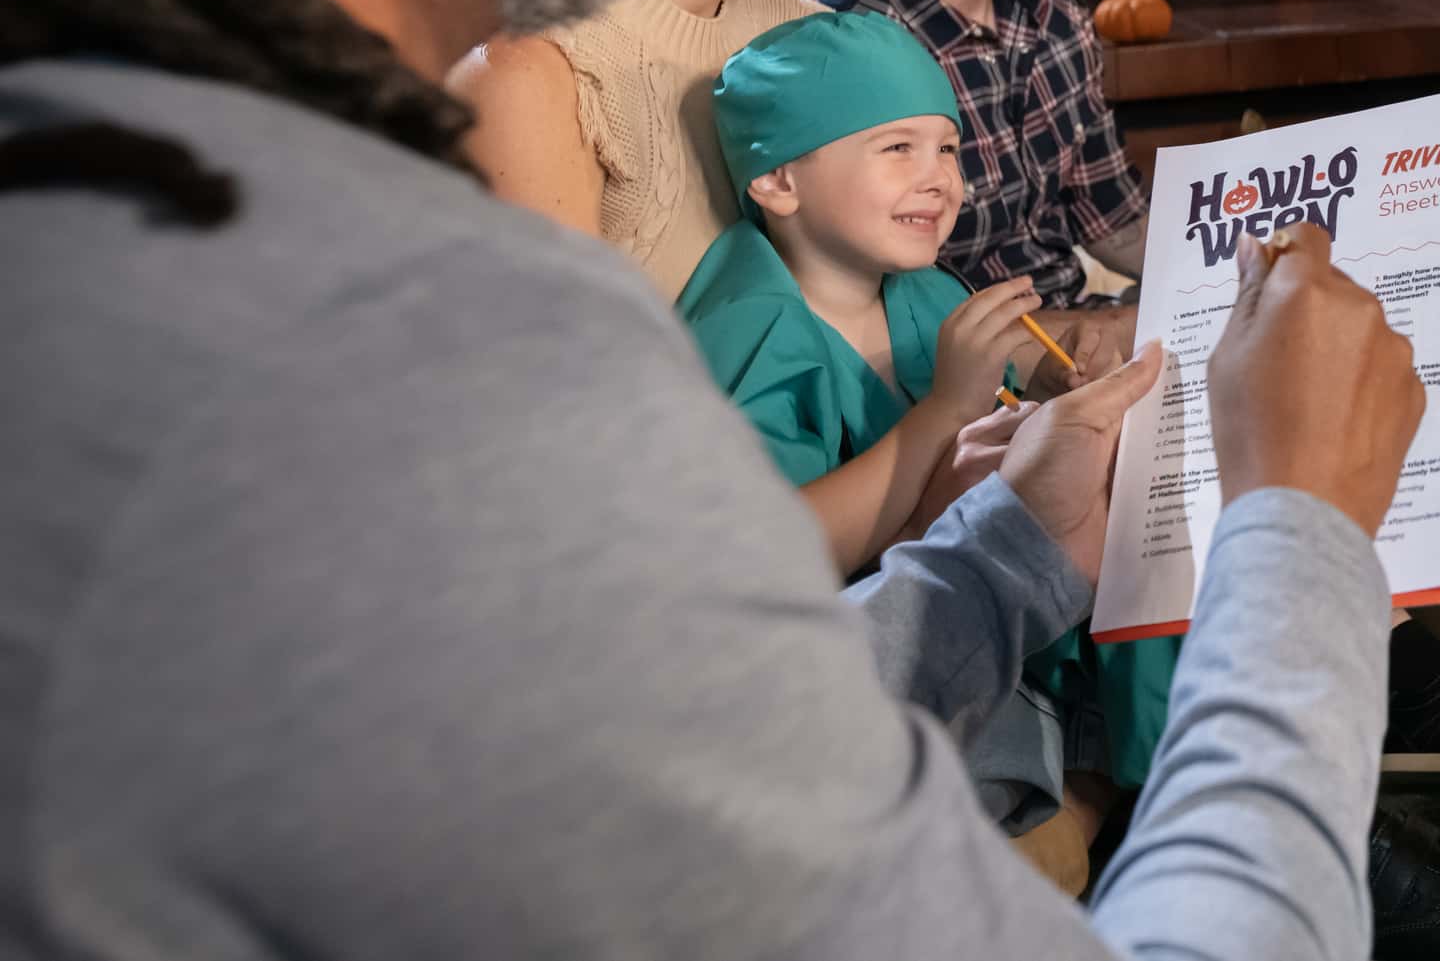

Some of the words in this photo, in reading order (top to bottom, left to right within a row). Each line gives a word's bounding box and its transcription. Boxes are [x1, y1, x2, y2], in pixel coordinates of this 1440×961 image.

[1379, 194, 1439, 217] Sheet
[1375, 279, 1410, 289] American
[1412, 274, 1440, 282] families
[1383, 271, 1413, 281] Roughly
[1386, 290, 1429, 302] Halloween?
